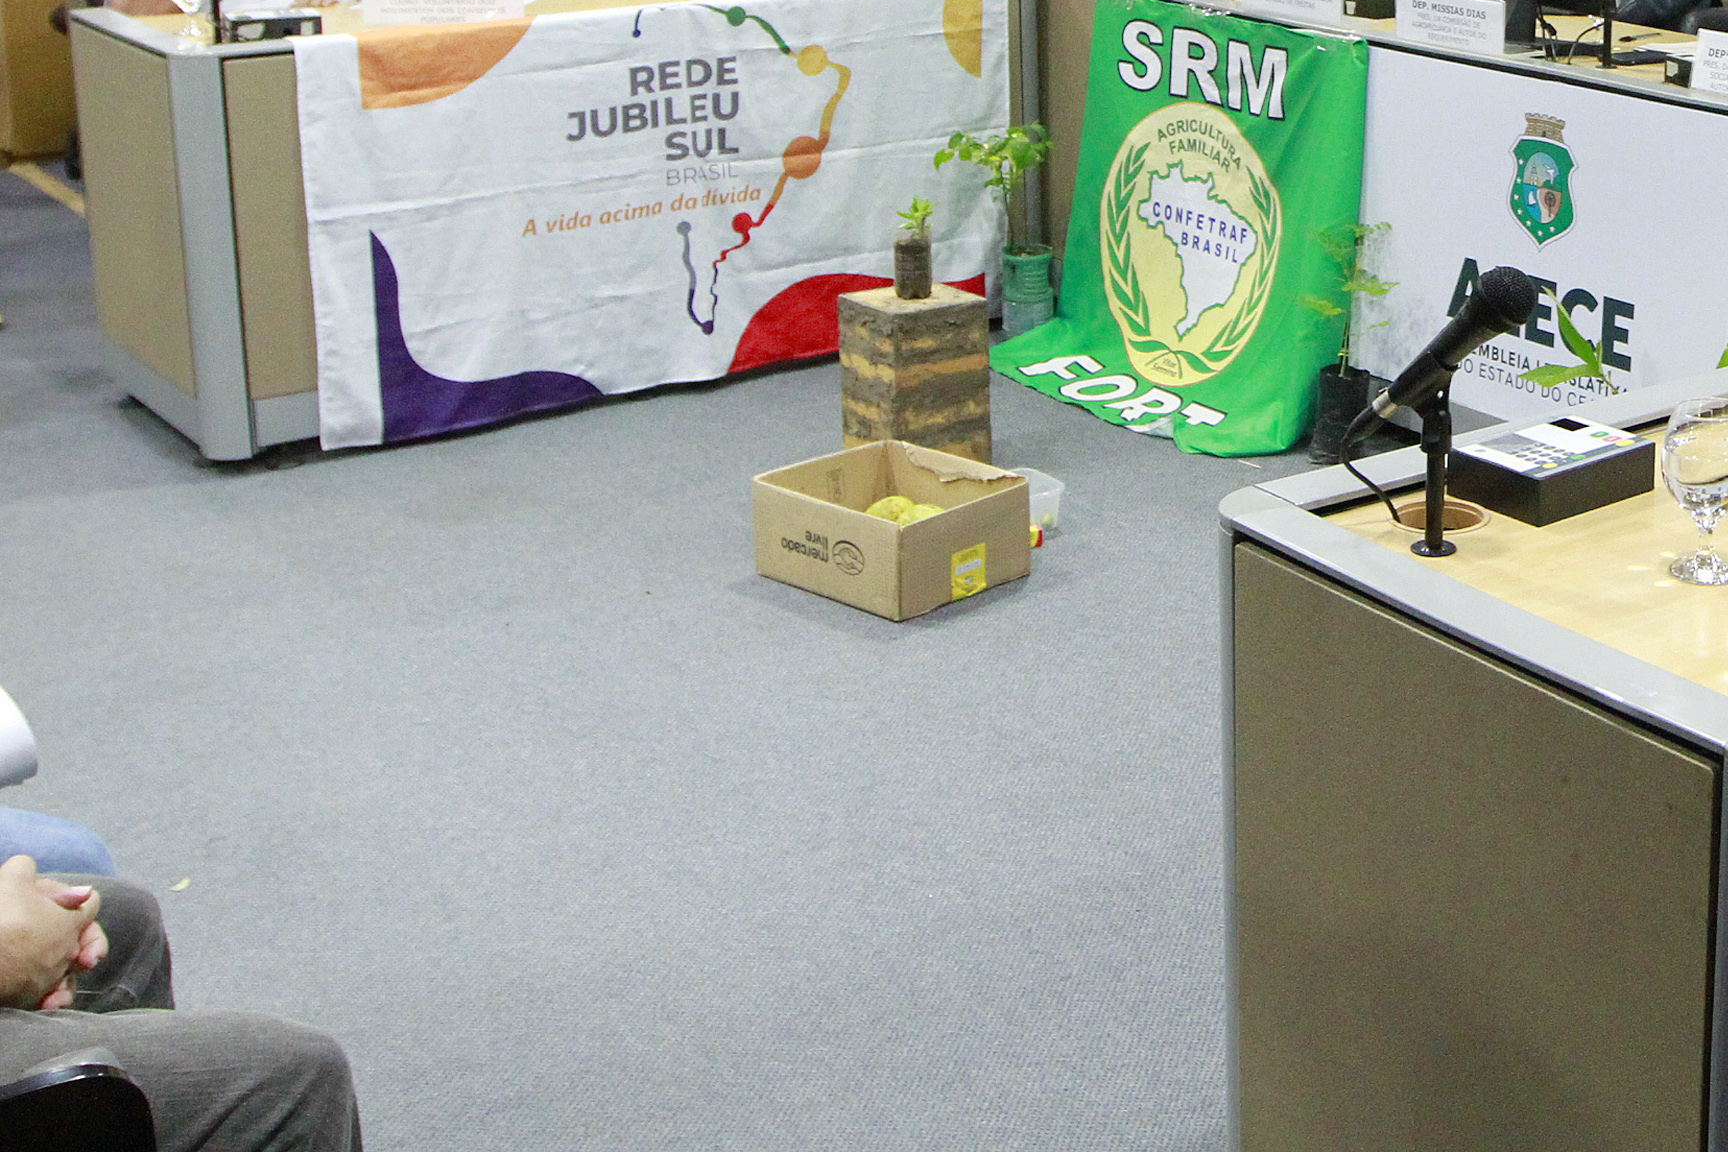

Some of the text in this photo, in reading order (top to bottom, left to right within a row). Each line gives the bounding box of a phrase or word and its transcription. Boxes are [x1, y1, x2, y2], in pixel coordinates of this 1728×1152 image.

[1412, 0, 1486, 20] DEP. MISSIAS DIAS
[628, 56, 739, 97] REDE
[1117, 18, 1289, 121] SRM
[1703, 59, 1718, 69] PRES.
[566, 91, 739, 142] JUBILEU
[664, 127, 740, 161] SUL
[1157, 118, 1242, 171] AGRICULTURA
[1168, 138, 1231, 173] FAMILIAR
[666, 162, 739, 187] BRASIL
[522, 185, 762, 237] A vida acima da dívida
[1152, 201, 1248, 244] CONFETRAF
[1181, 231, 1238, 264] BRASIL
[1446, 257, 1636, 373] AECE
[1478, 362, 1536, 394] ESTADO
[781, 537, 829, 563] mercado
[805, 530, 828, 550] livre
